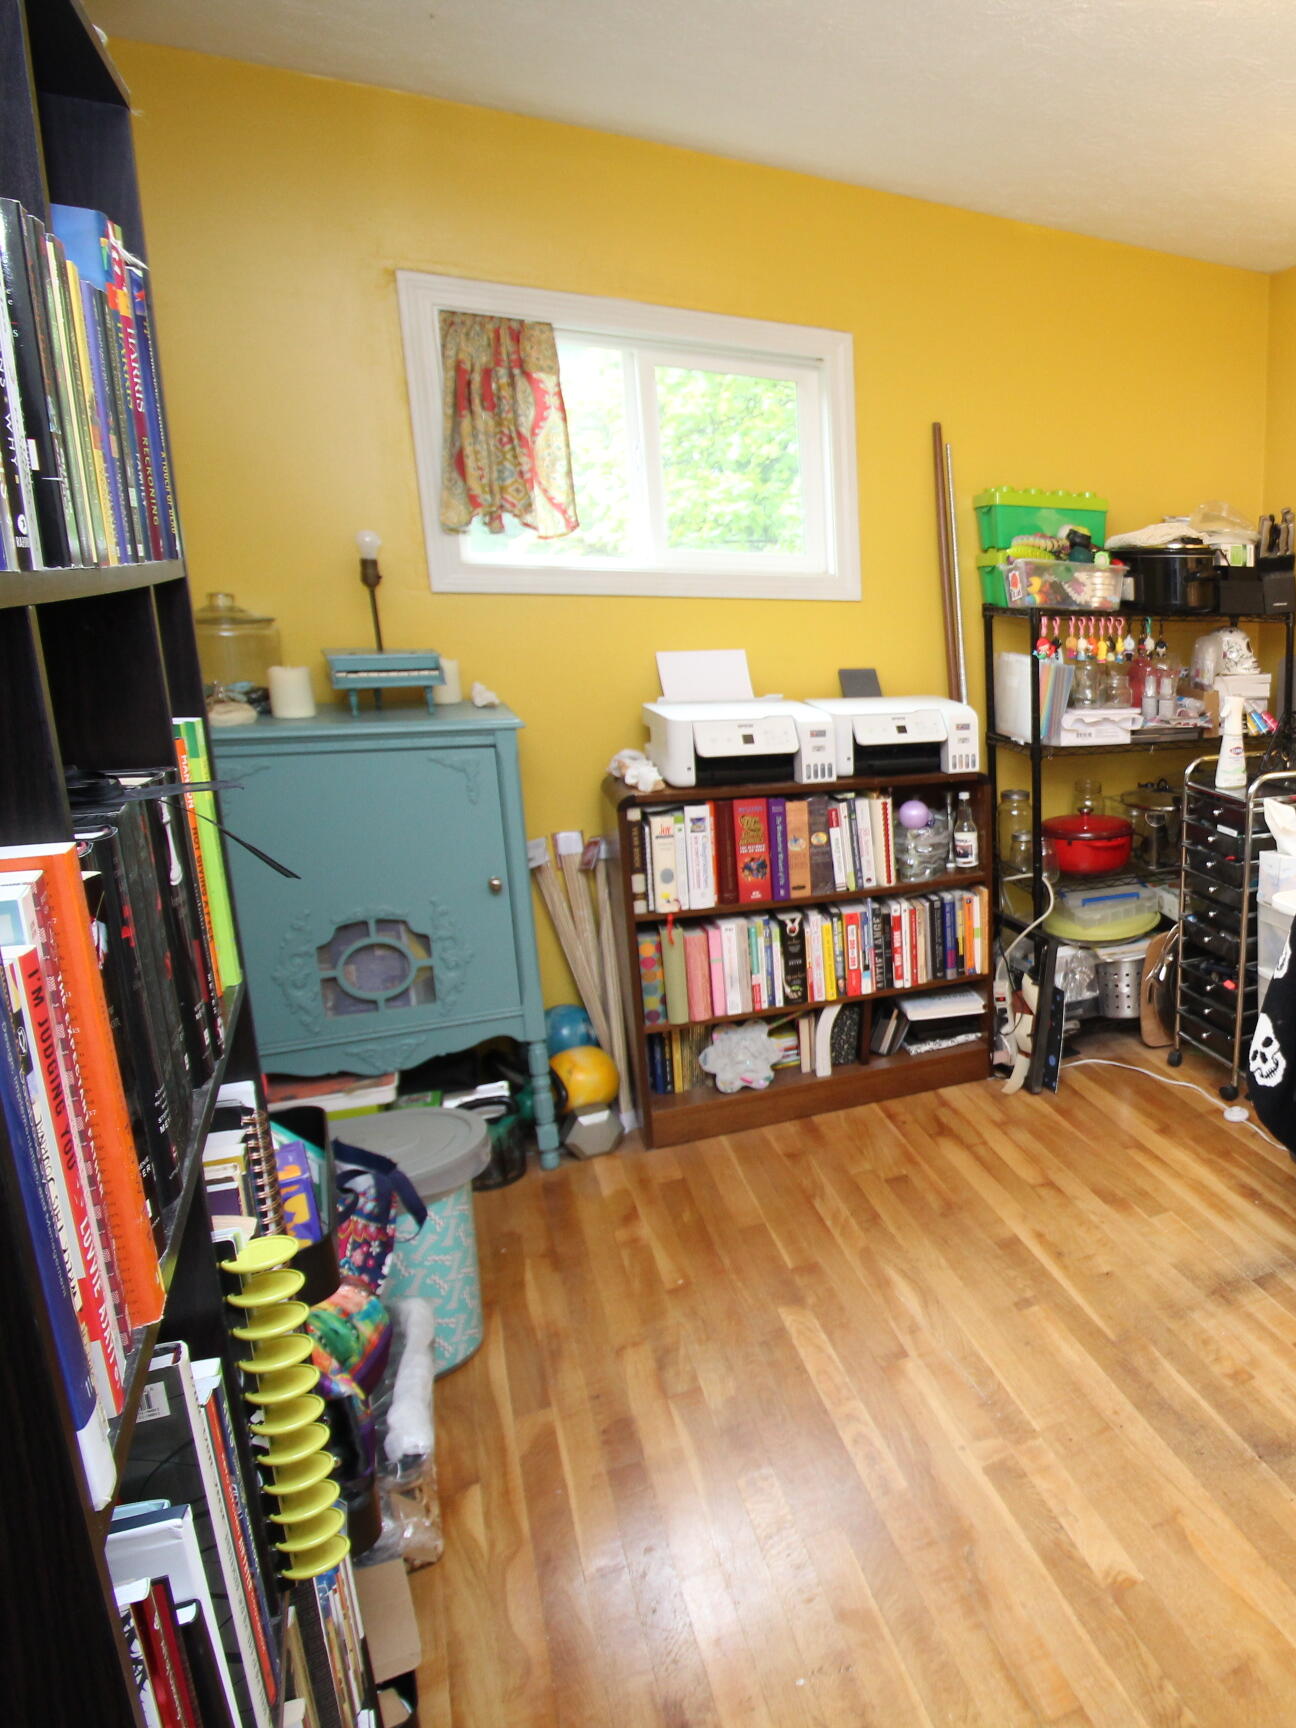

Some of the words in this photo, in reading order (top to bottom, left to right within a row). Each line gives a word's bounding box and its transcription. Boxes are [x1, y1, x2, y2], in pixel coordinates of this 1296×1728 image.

[127, 328, 144, 412] HARRIS
[142, 437, 159, 525] RECKONING
[181, 755, 194, 808] MANON
[28, 968, 45, 1008] I'M
[38, 1016, 67, 1116] JUDGING
[61, 1127, 78, 1171] YOU
[79, 1216, 102, 1298] LUVVIE
[98, 1305, 115, 1364] AJAYI
